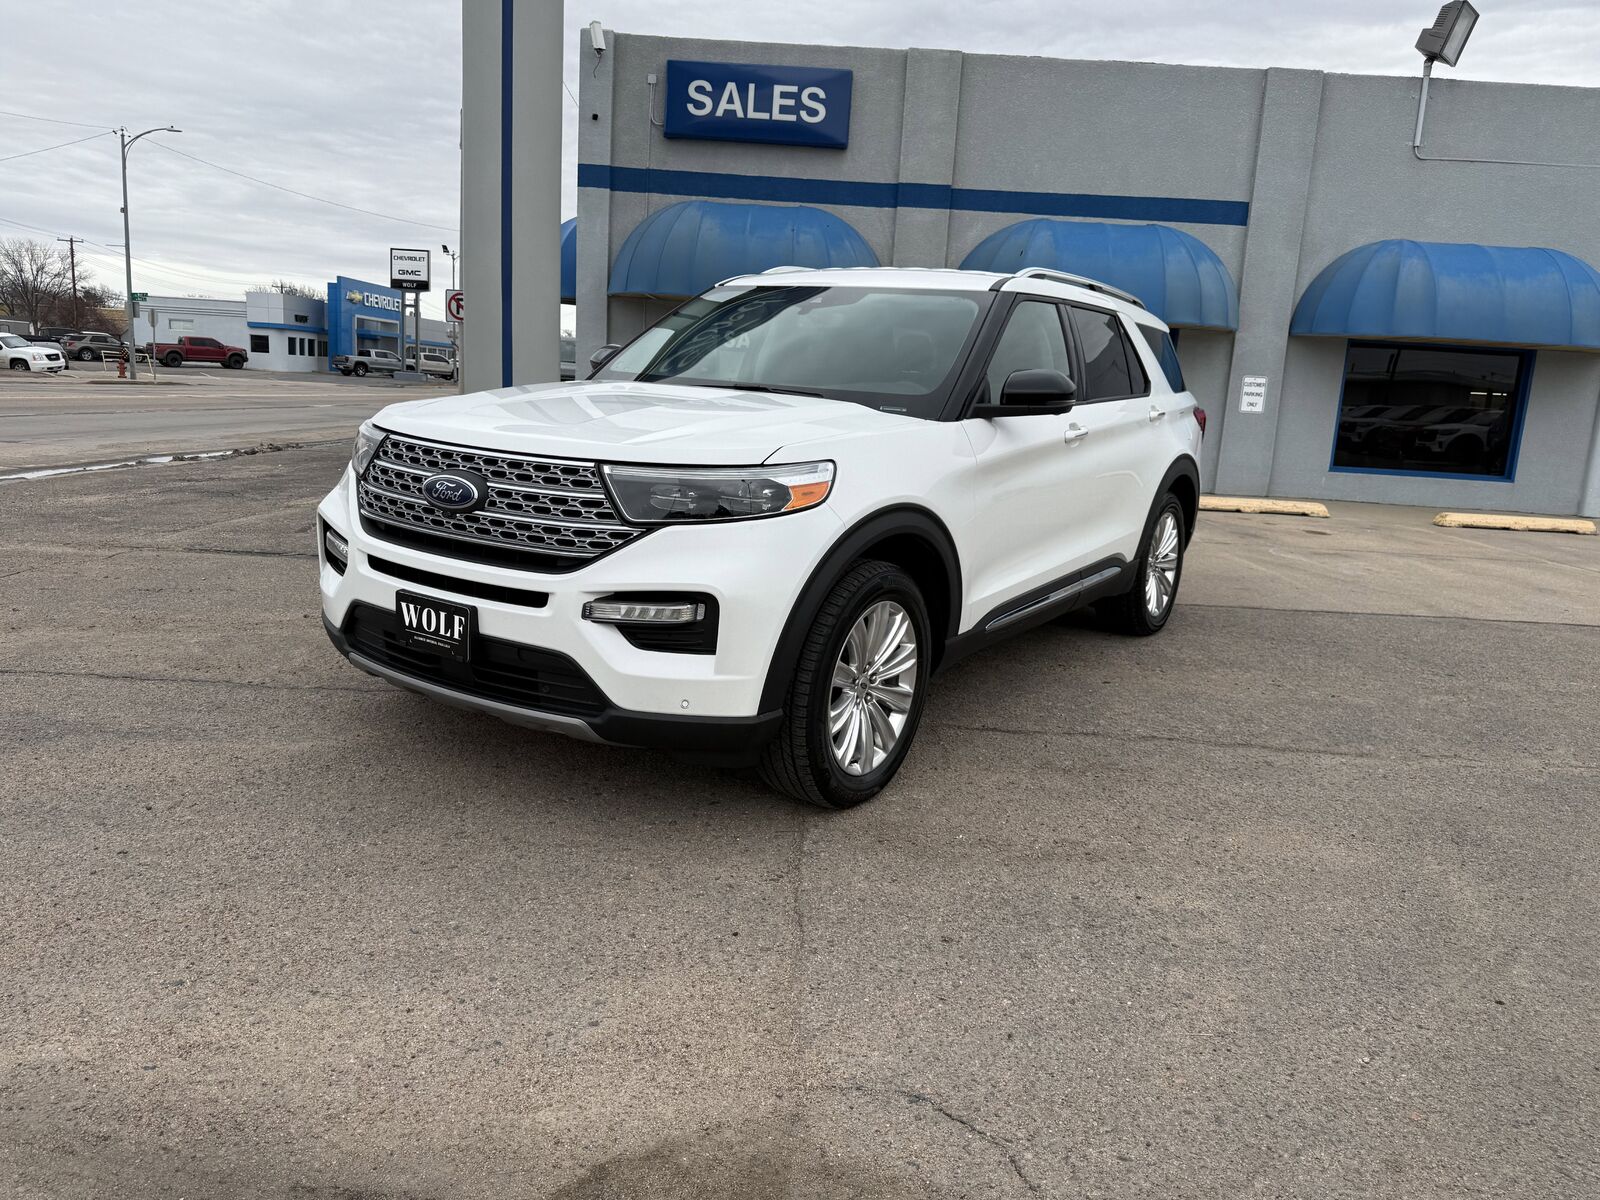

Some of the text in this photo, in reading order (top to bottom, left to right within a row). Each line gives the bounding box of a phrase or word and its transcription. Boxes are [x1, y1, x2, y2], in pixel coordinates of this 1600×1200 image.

[686, 79, 827, 124] SALES
[432, 481, 462, 501] Ford
[400, 601, 465, 640] WOLF
